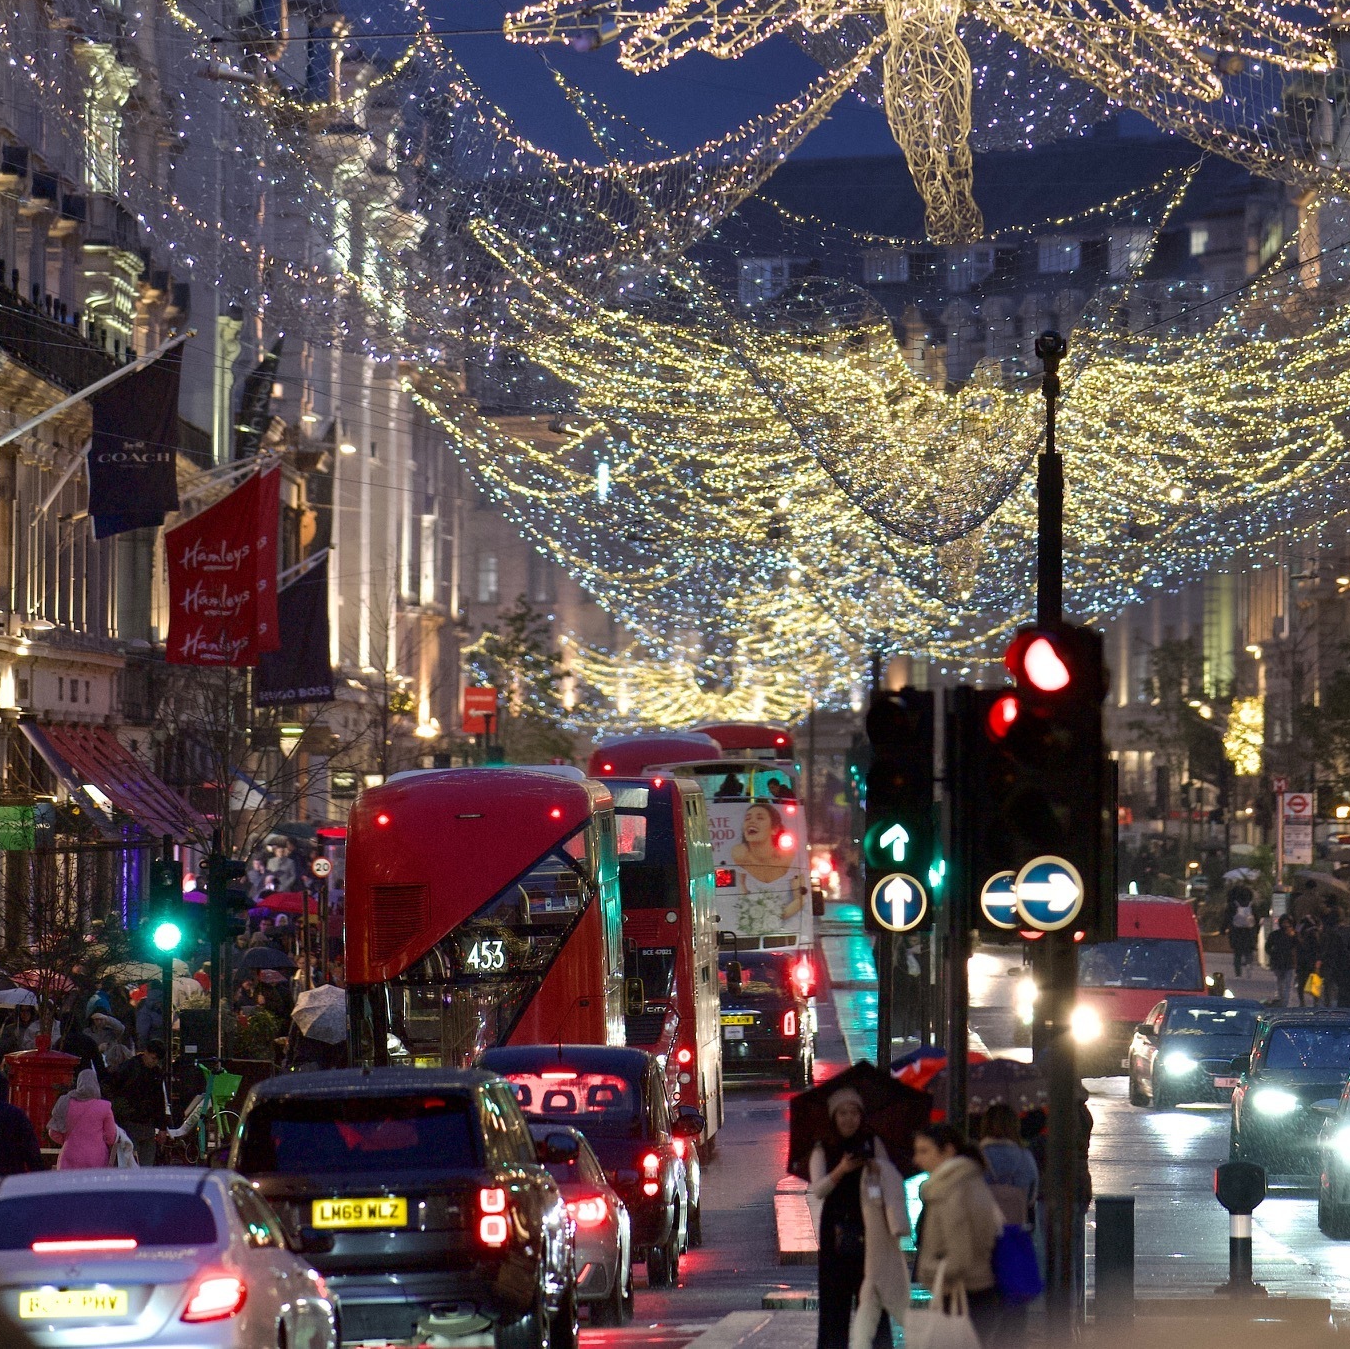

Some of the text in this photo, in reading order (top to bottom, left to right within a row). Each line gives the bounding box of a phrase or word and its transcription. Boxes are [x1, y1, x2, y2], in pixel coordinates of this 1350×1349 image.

[98, 452, 170, 463] COACH
[180, 538, 250, 571] Hamleys
[180, 580, 250, 617] Hamleys
[298, 685, 331, 697] BOSS
[316, 862, 329, 871] 20
[467, 941, 505, 969] 453
[321, 1203, 399, 1221] LM69 WLZ
